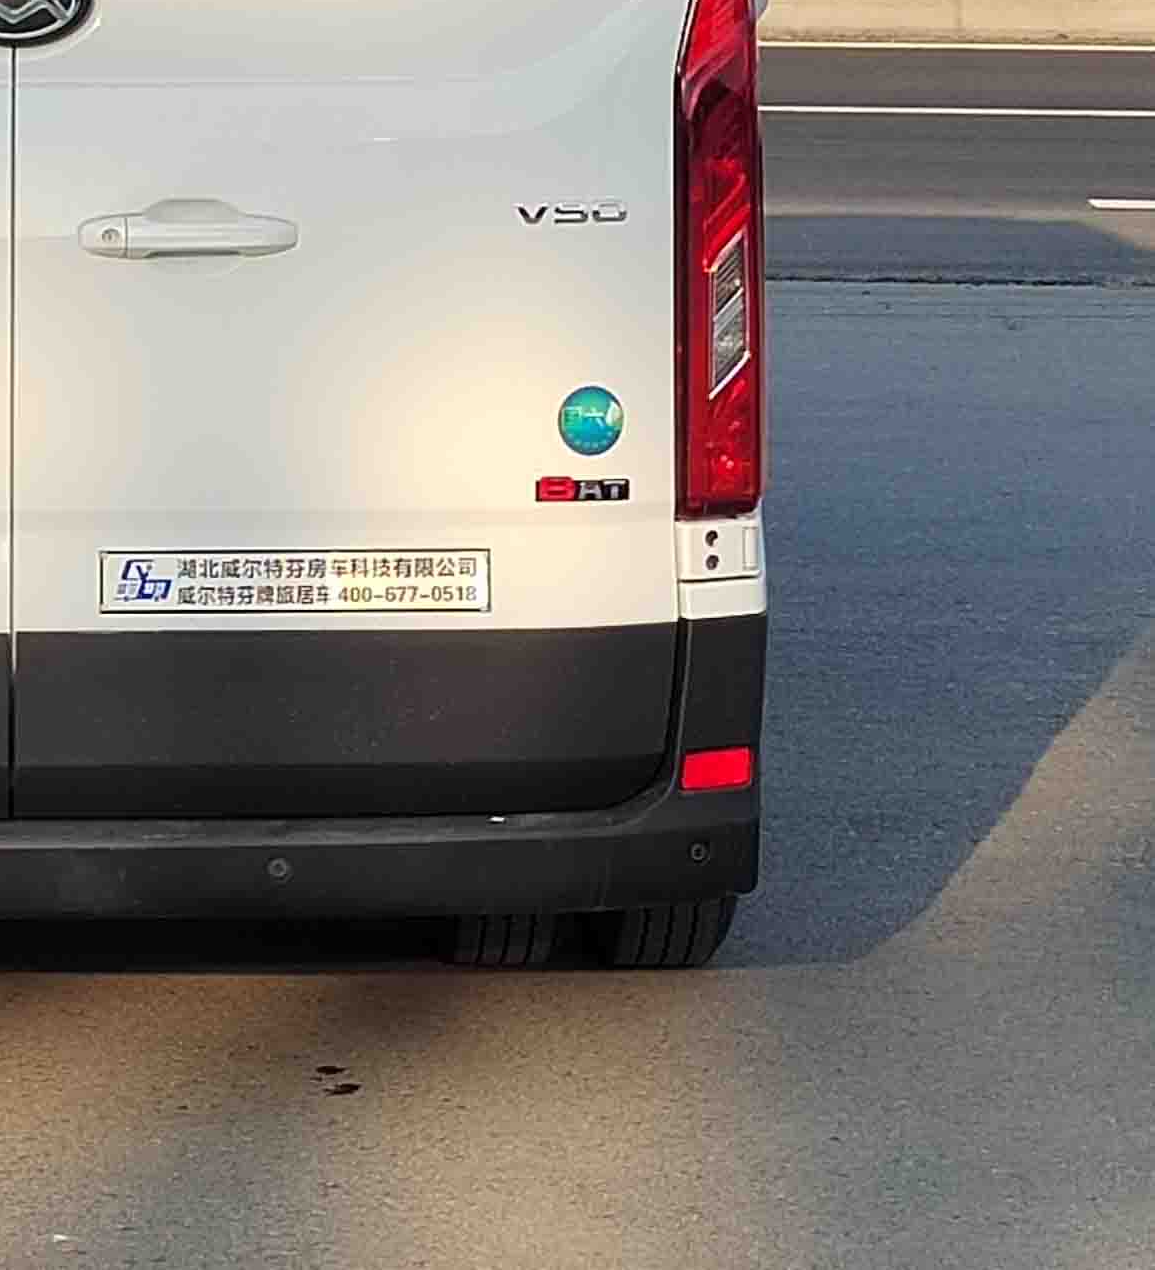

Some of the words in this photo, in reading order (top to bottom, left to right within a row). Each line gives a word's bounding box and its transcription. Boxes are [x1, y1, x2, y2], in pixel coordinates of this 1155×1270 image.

[177, 557, 478, 579] 湖北威尔特芬房车科技有限公司
[337, 585, 478, 603] 400-677-0518
